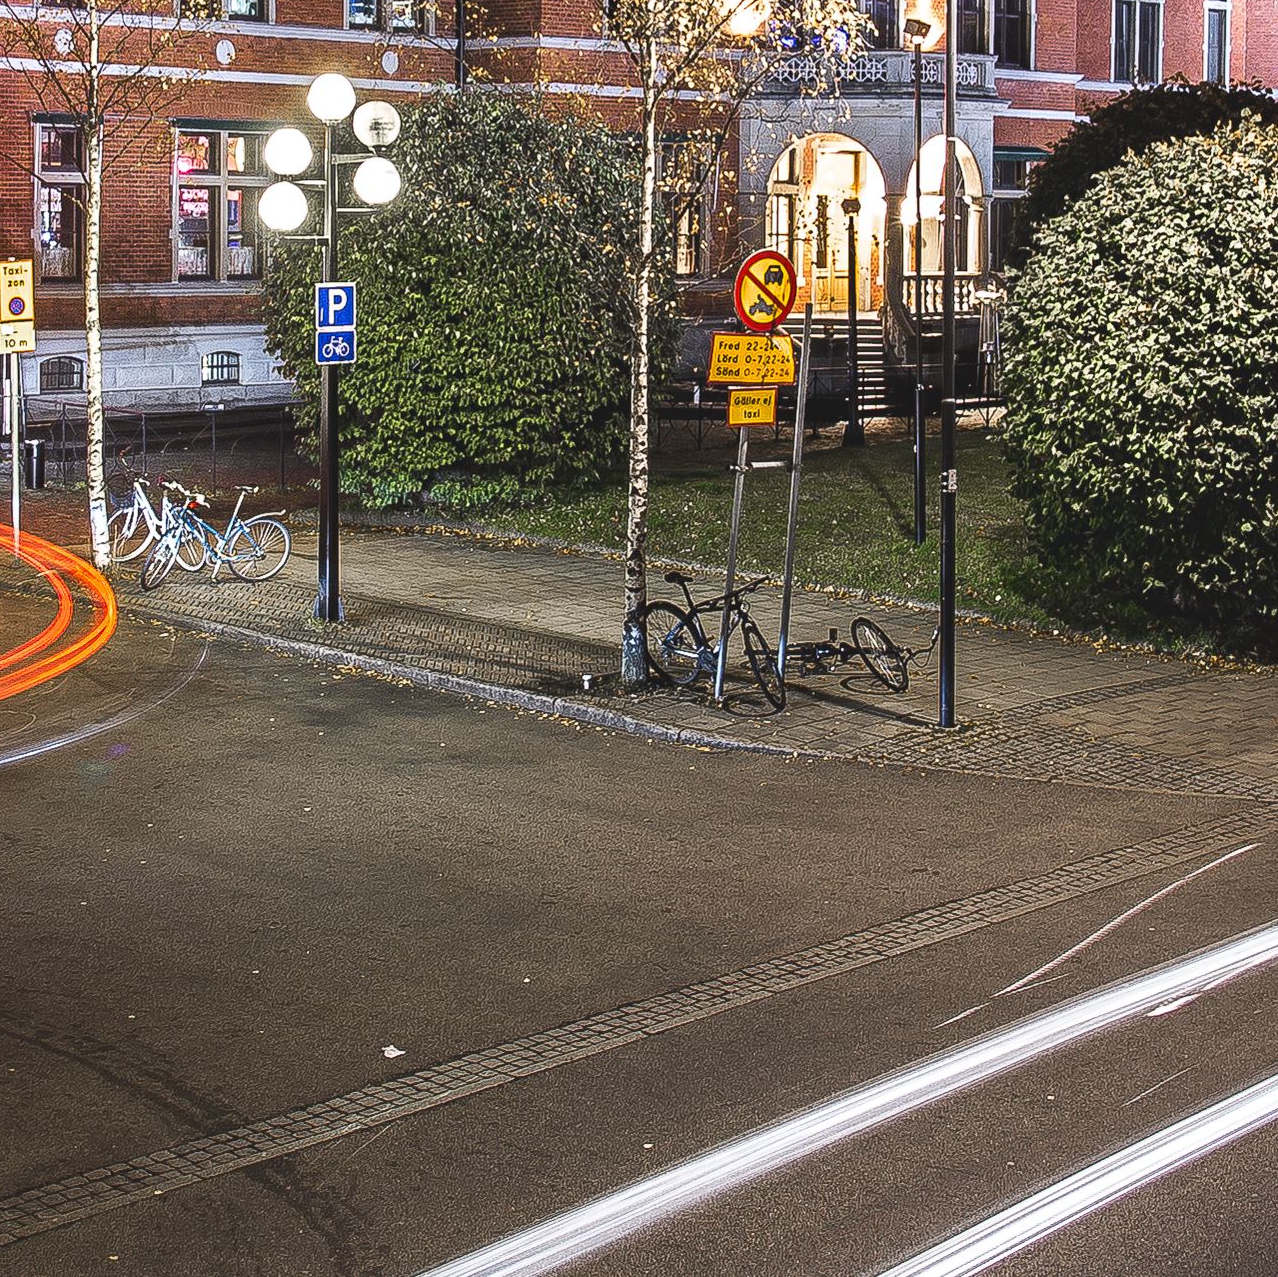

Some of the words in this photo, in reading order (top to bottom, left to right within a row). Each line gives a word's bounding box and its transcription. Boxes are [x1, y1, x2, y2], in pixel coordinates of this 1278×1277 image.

[3, 265, 28, 276] Taxi-
[7, 279, 25, 288] zon
[328, 288, 348, 325] P
[4, 338, 16, 348] 10
[19, 339, 28, 347] m
[718, 341, 740, 351] Fred
[717, 354, 739, 363] Lörd
[715, 365, 740, 377] Sönd
[734, 396, 761, 406] Gäller
[763, 396, 772, 406] ej
[743, 409, 760, 419] taxi
